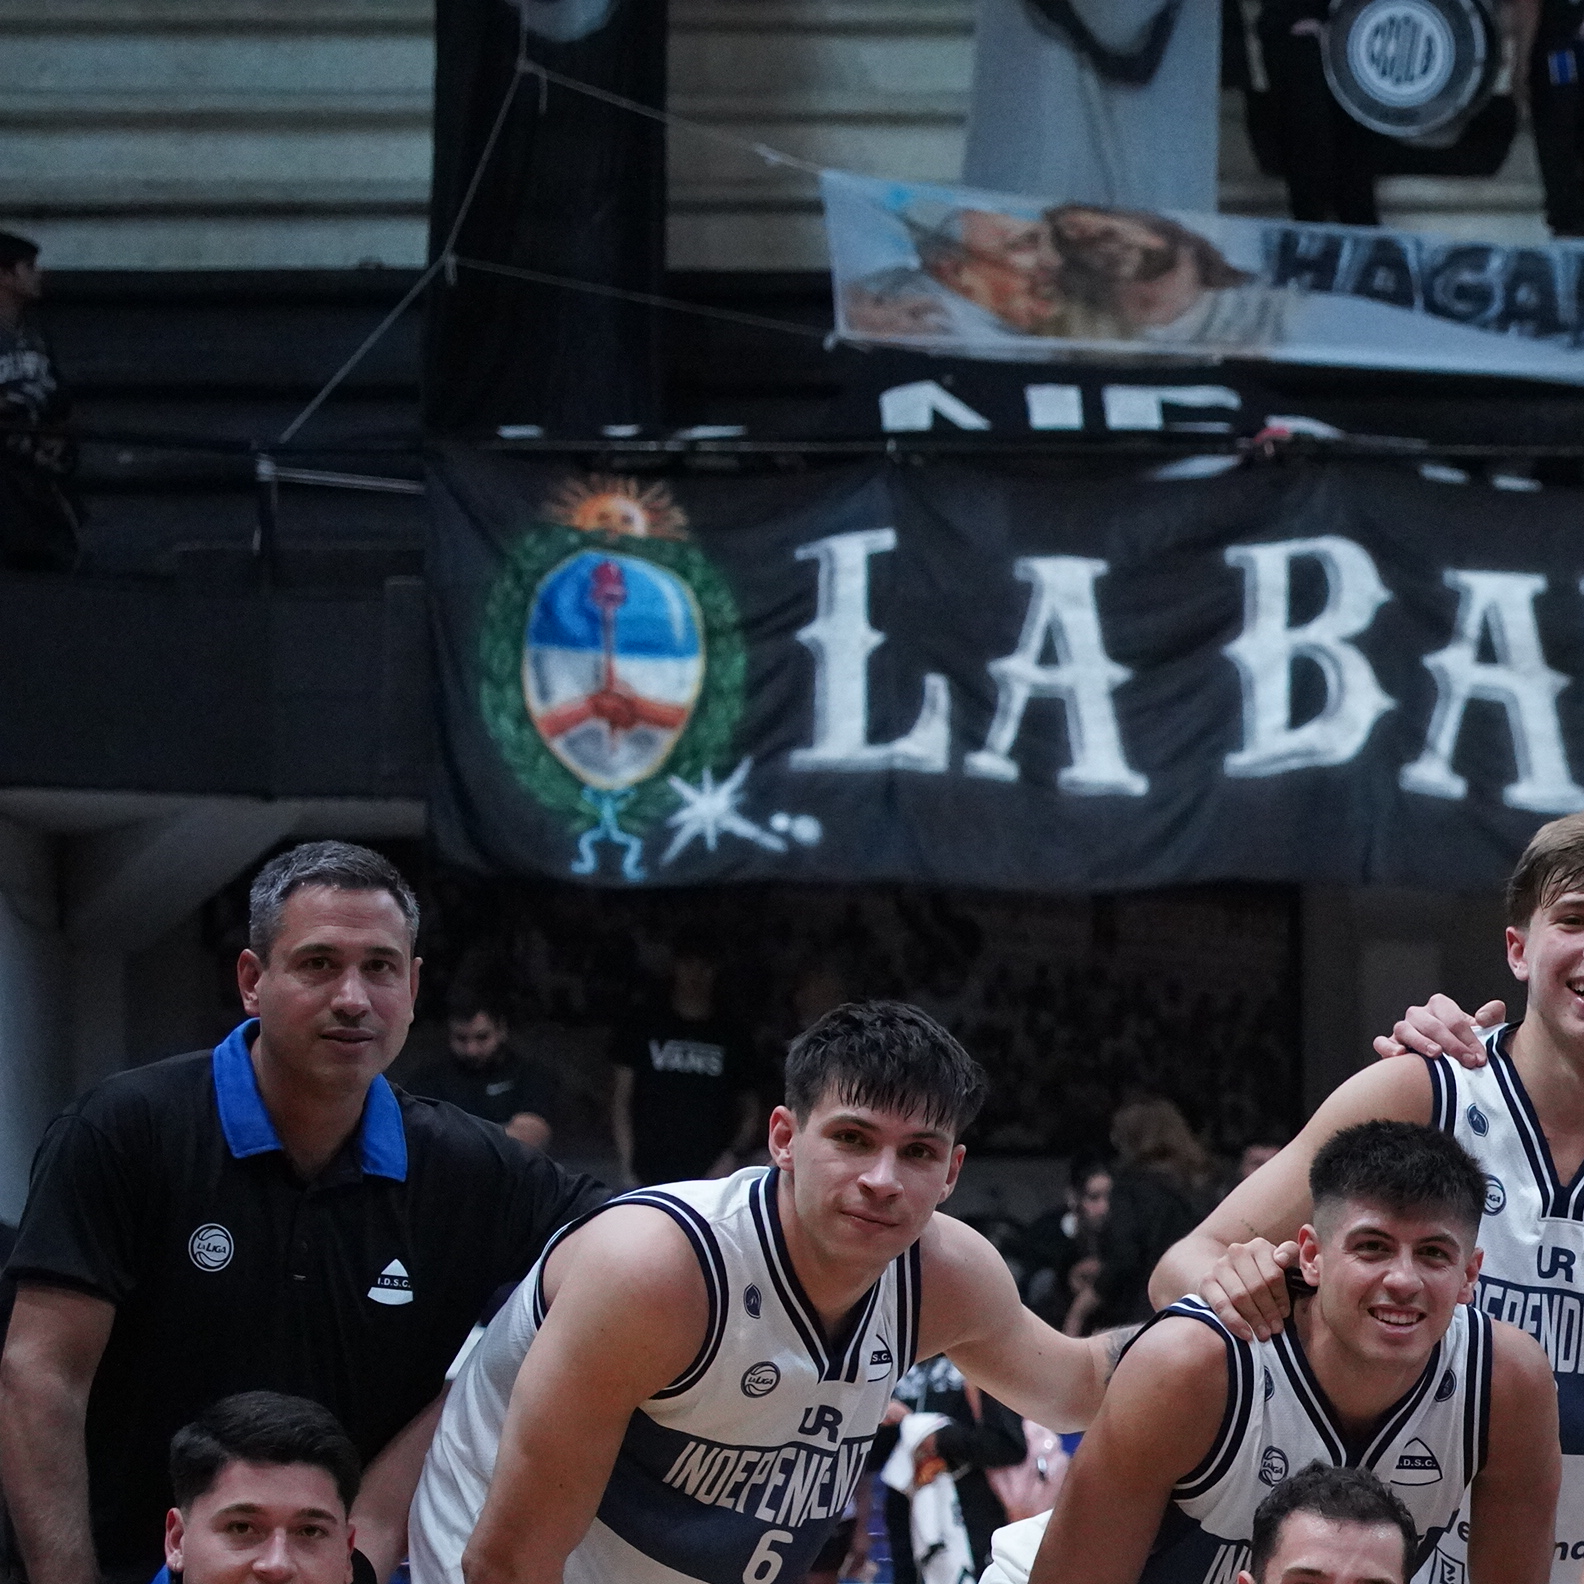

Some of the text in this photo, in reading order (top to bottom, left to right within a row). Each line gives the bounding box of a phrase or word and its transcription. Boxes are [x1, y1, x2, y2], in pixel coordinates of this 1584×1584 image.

[787, 527, 1150, 798] LA
[377, 1277, 411, 1288] I.D.S.C.
[1536, 1245, 1577, 1283] UR
[798, 1404, 843, 1444] UR
[1400, 1458, 1437, 1467] .D.S.C.
